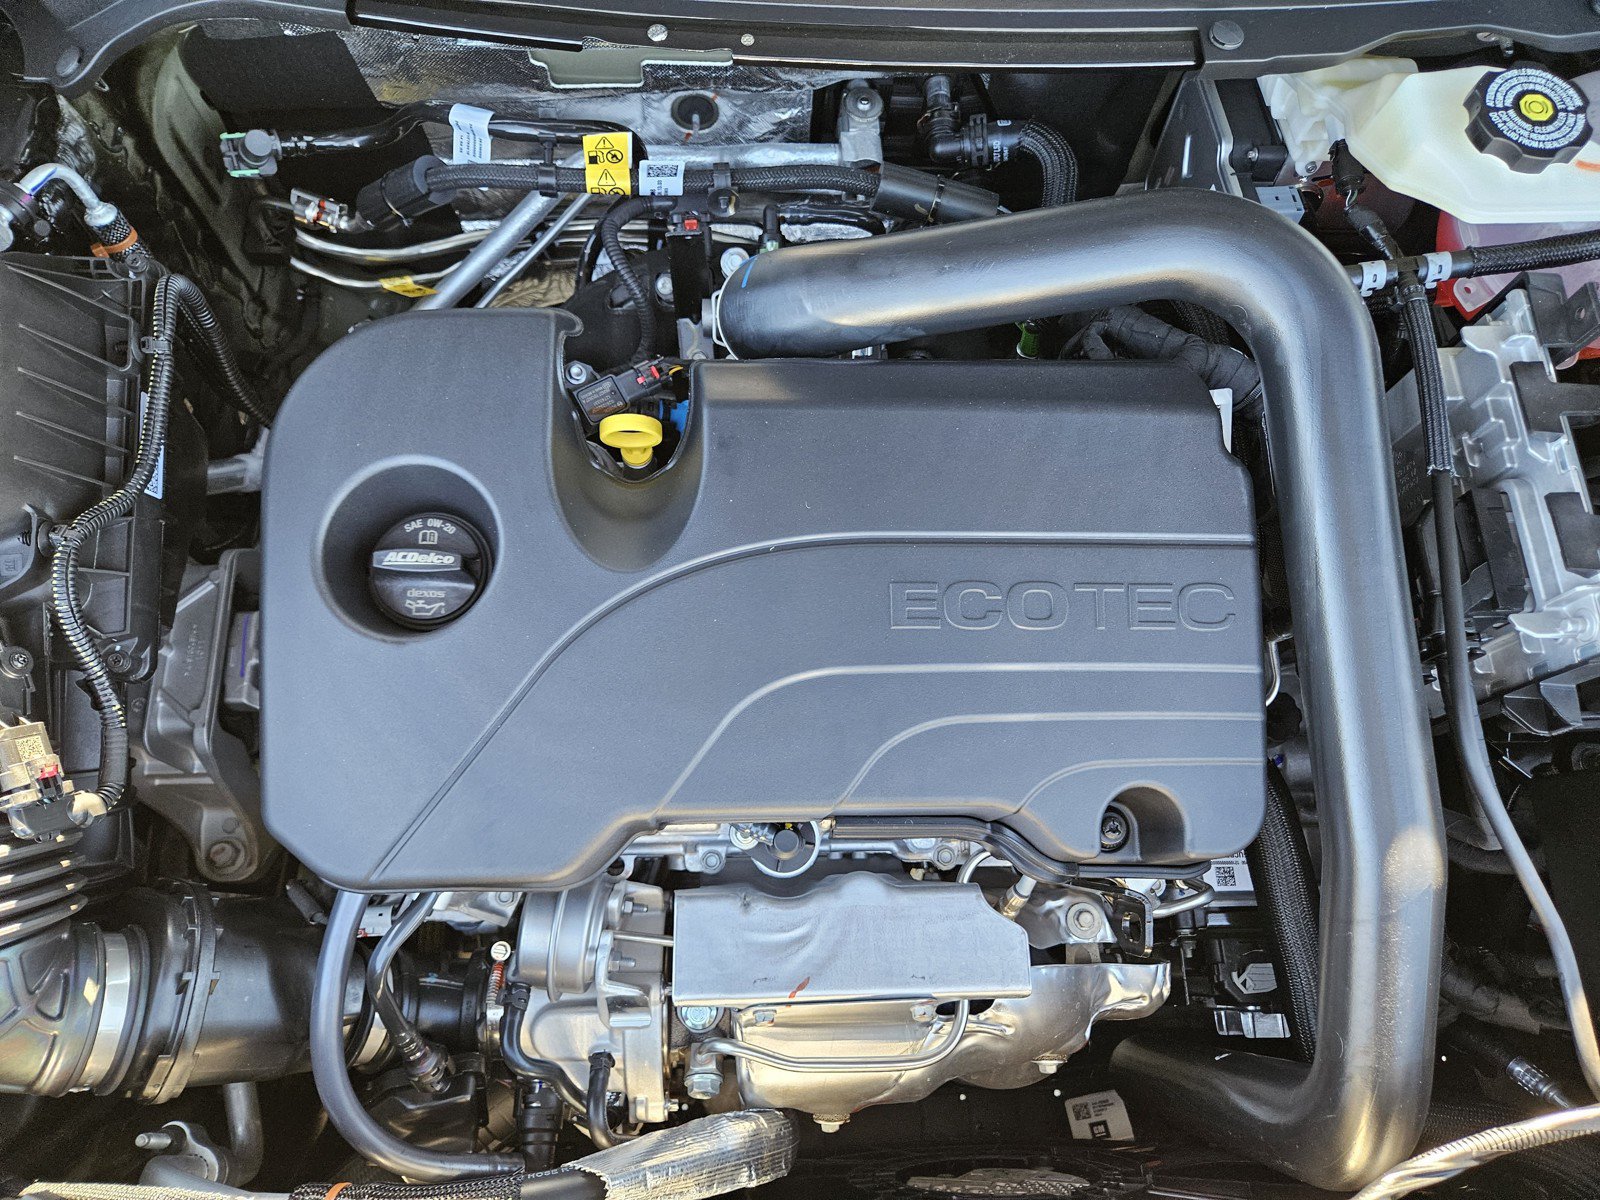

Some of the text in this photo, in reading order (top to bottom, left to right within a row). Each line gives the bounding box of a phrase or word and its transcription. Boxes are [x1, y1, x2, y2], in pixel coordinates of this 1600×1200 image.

[1499, 125, 1519, 140] FLUID
[1517, 136, 1538, 148] FROM
[404, 518, 456, 534] SAE 0W-20
[382, 552, 455, 565] ACDelco
[407, 588, 446, 598] dexos
[889, 580, 1236, 632] ECOTEC
[527, 1168, 559, 1179] HOSE
